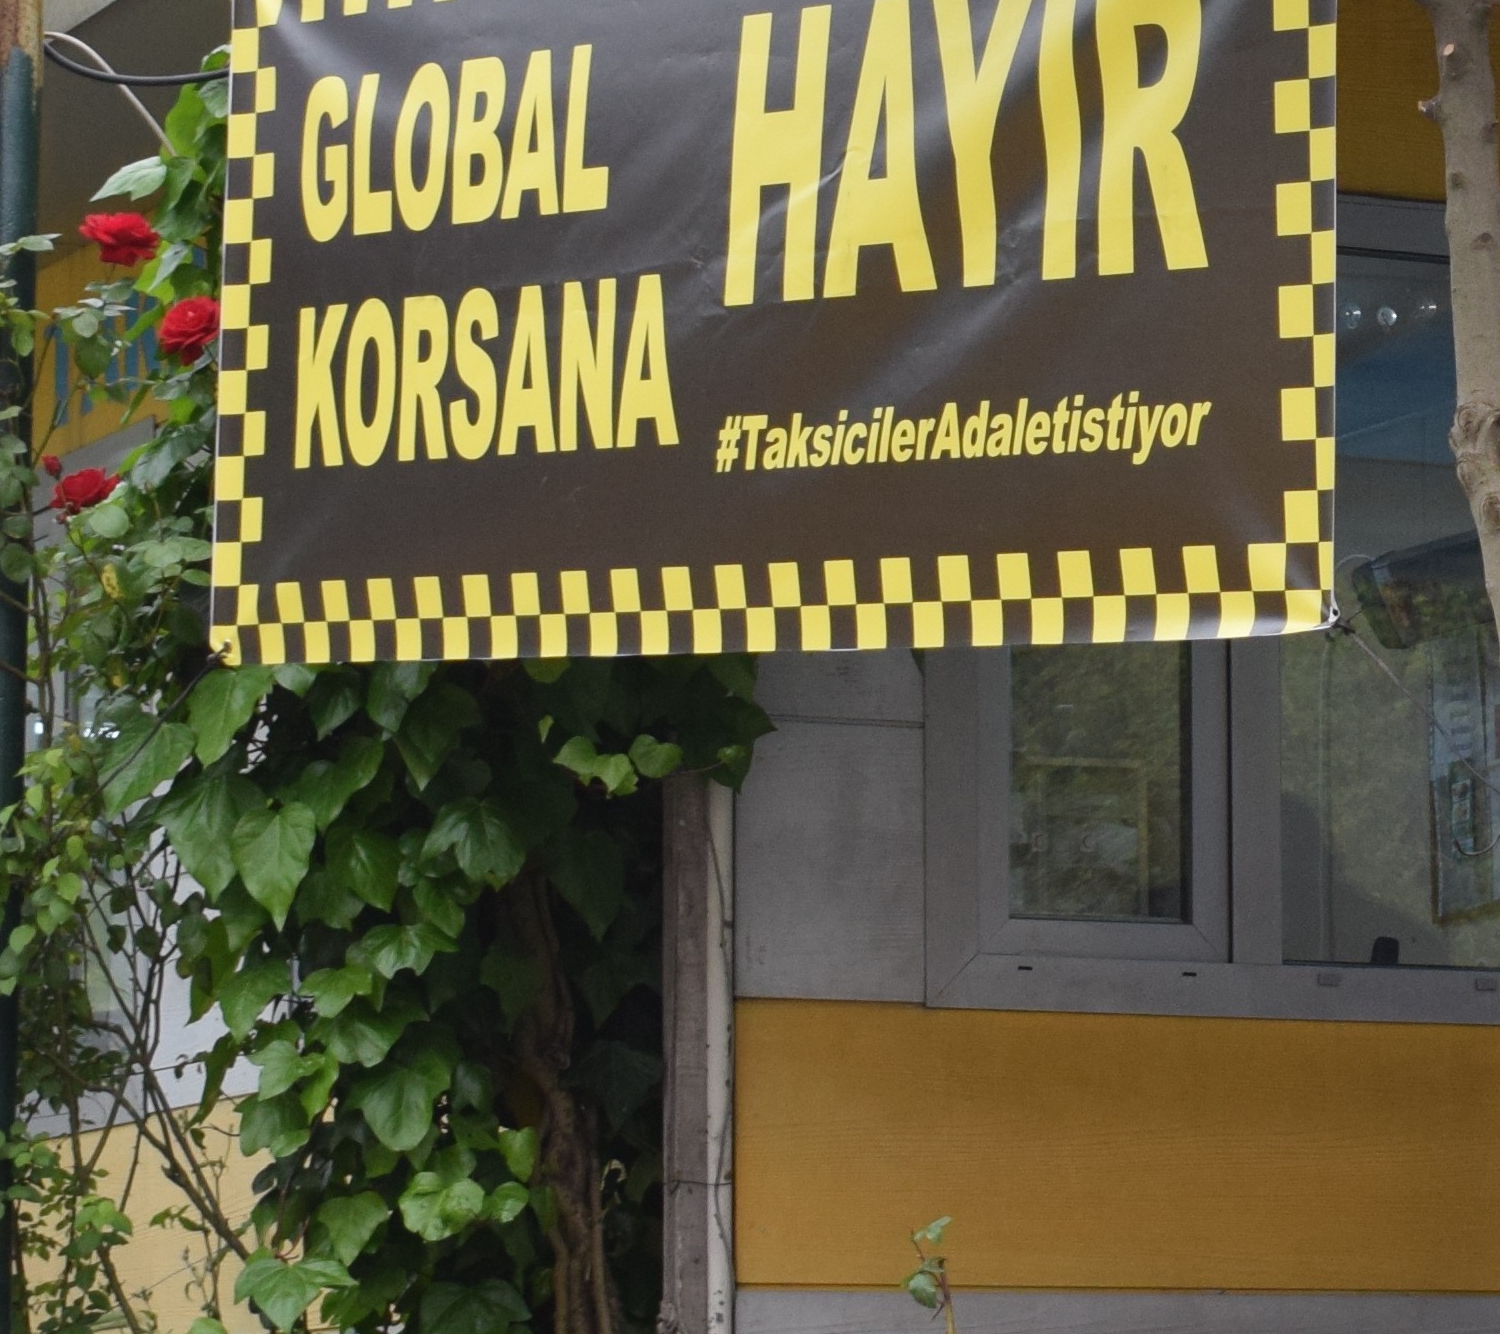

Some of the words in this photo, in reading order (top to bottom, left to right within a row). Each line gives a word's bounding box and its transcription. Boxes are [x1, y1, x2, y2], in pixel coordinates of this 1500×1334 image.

[301, 43, 610, 243] GLOBAL
[293, 273, 680, 470] KORSANA
[715, 389, 1212, 474] #TaksicilerAdaletistiyor
